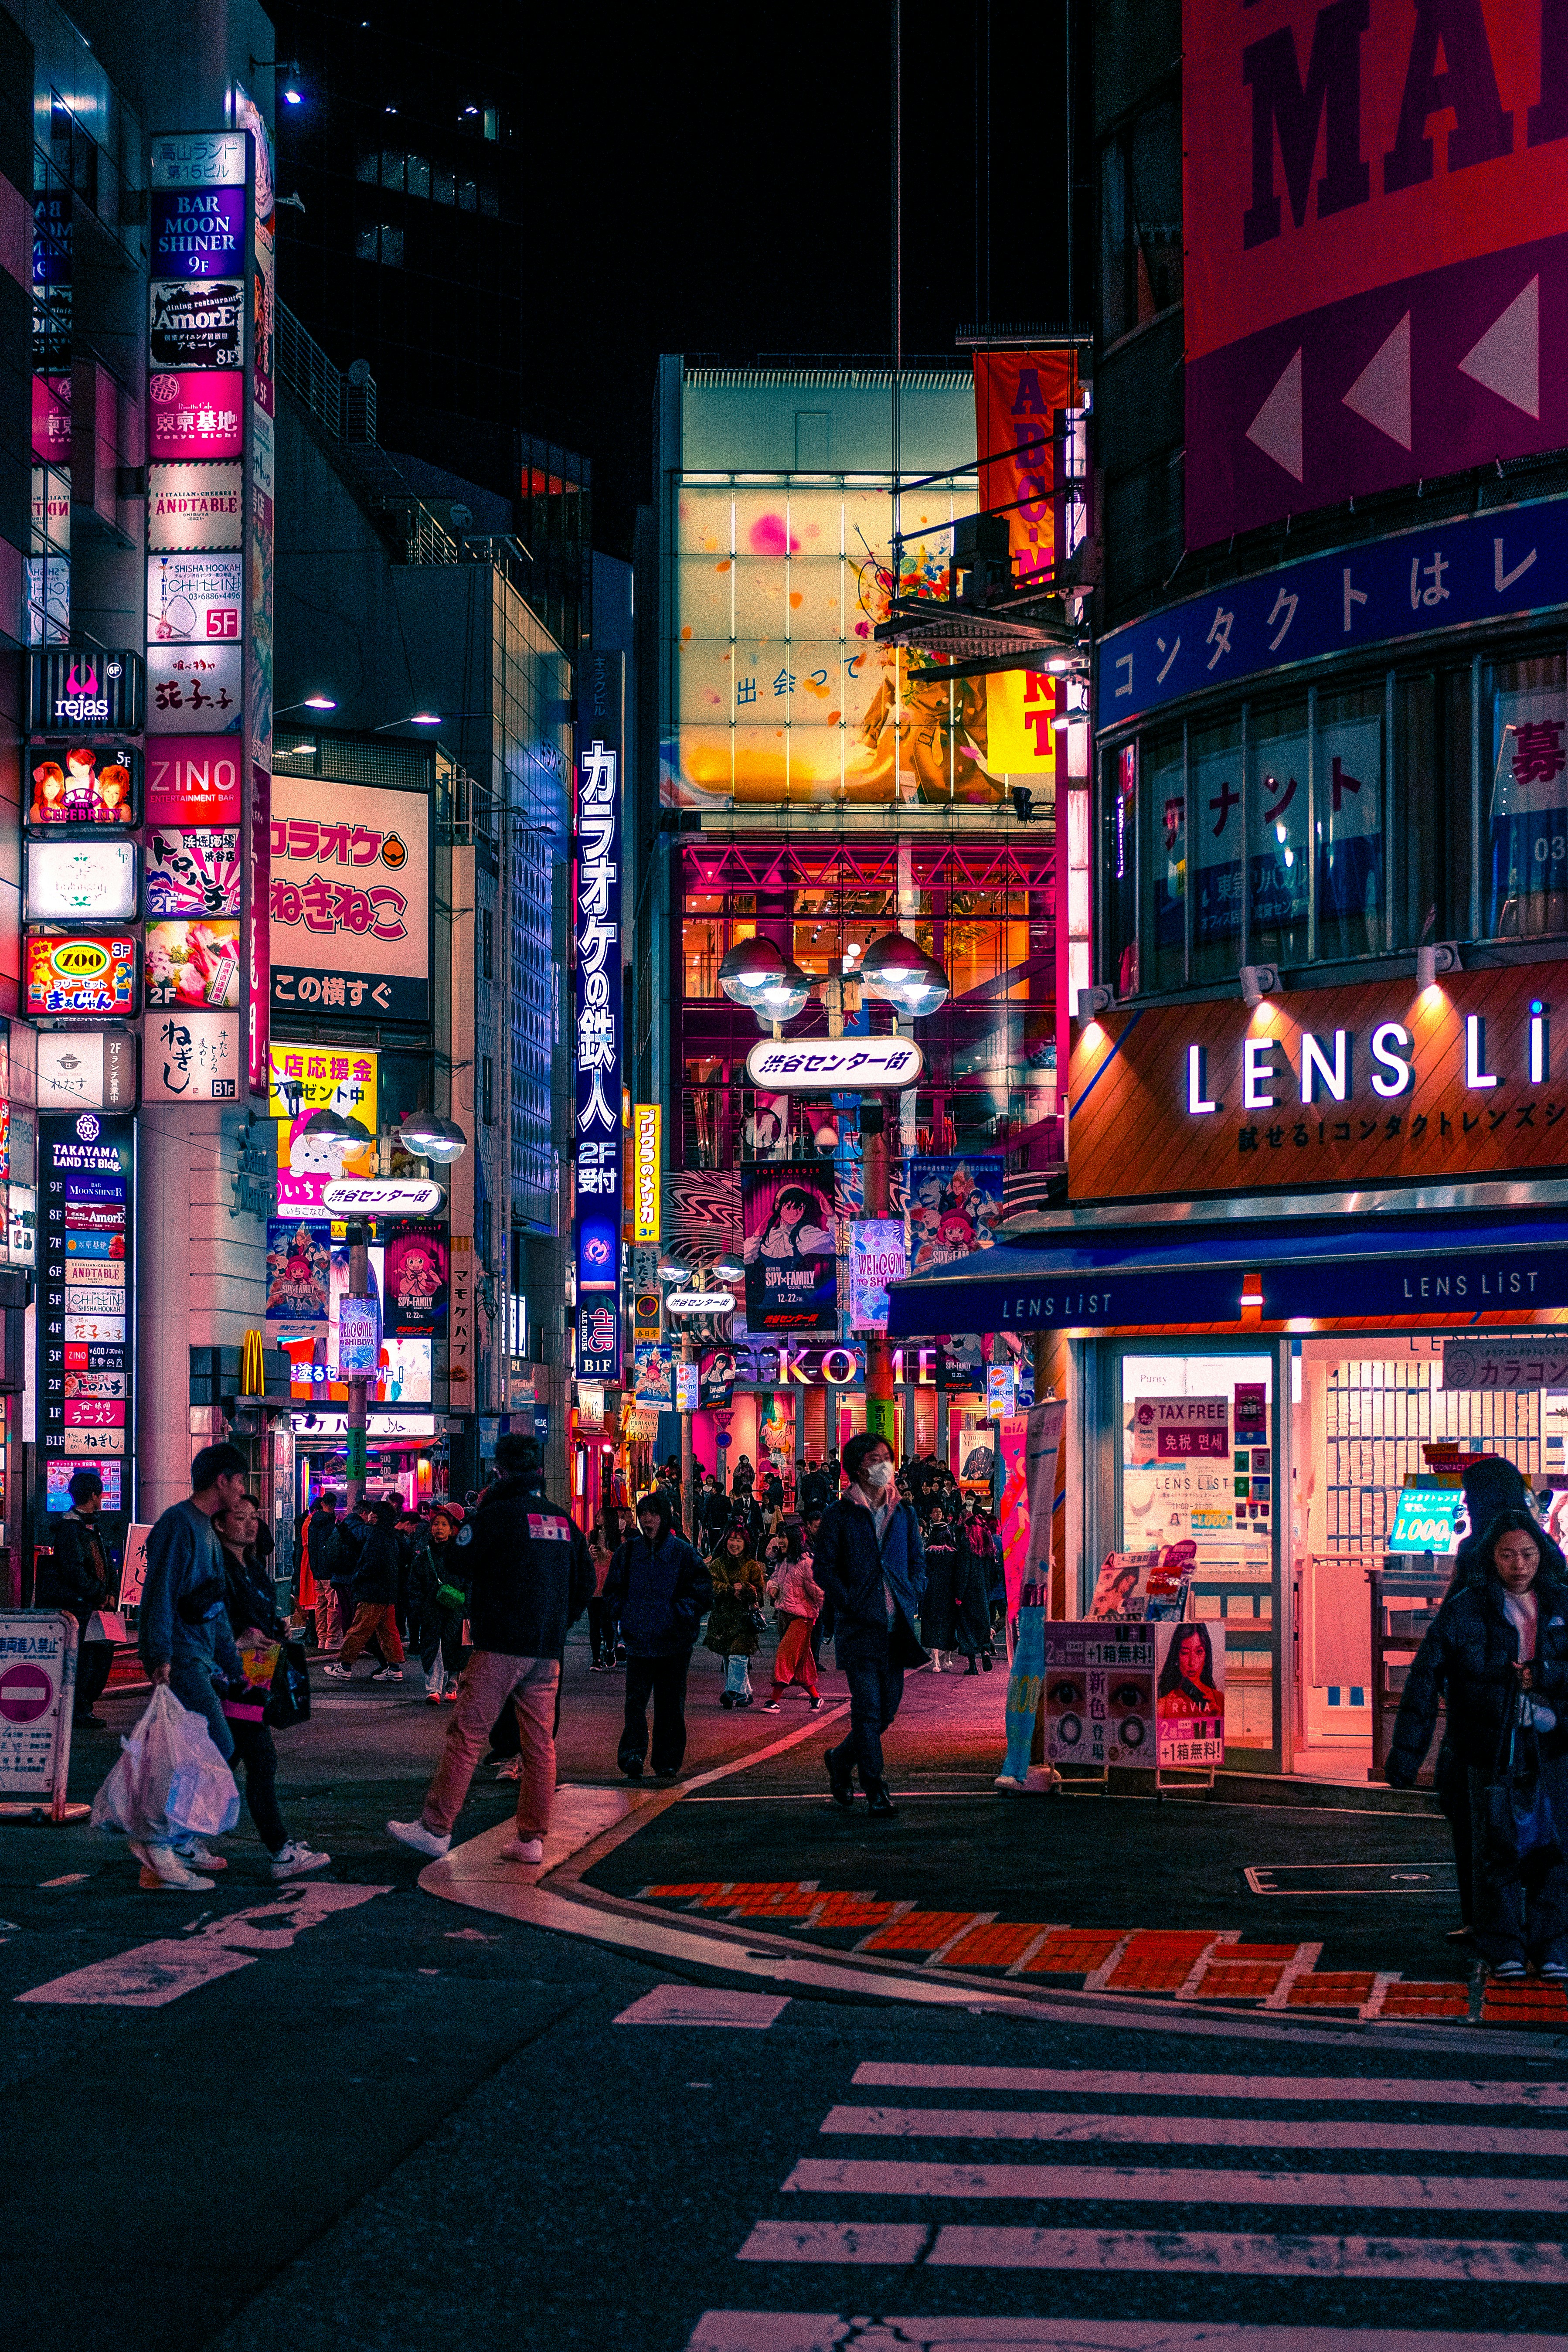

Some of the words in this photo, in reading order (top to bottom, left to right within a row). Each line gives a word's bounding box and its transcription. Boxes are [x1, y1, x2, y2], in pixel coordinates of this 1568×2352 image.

[160, 143, 237, 161] 高山ランド
[167, 164, 229, 180] 第15ビル
[177, 196, 220, 213] BAR
[166, 216, 229, 235] MOON
[159, 235, 236, 252] SHINER
[188, 256, 209, 273] 9F
[166, 302, 192, 312] dining
[154, 306, 237, 329] AmorE
[178, 341, 217, 351] アモーレ
[216, 349, 238, 364] 8F
[155, 497, 238, 515] ANDTABLE
[175, 565, 204, 573] SHISHA
[206, 564, 241, 572] HOOKAH
[208, 612, 236, 635] 5F
[1115, 538, 1537, 697] コンタクトはレ
[109, 665, 119, 674] 6F
[737, 655, 860, 705] 出会って
[55, 694, 108, 721] rejas
[116, 751, 131, 767] 5F
[150, 760, 236, 791] ZINO
[150, 794, 216, 803] ENTERTAINMENT
[40, 807, 123, 822] CELEBRITY
[115, 848, 129, 864] 4F
[204, 851, 235, 862] 渋谷店
[151, 896, 178, 912] 2F
[578, 740, 617, 1133] カラオケの鉄人
[112, 943, 130, 958] 3F
[62, 953, 102, 967] ZOO
[54, 980, 80, 990] フリー
[83, 980, 108, 989] セット
[275, 974, 392, 1009] この横すぐ
[150, 987, 177, 1004] 2F
[110, 1043, 121, 1054] 2F
[218, 1030, 229, 1058] 牛たん
[160, 1018, 193, 1095] ねぎし
[197, 1038, 207, 1067] 麦めし
[758, 1051, 913, 1073] 渋谷センター街
[1187, 1021, 1412, 1115] LENS
[51, 1078, 87, 1090] れたす
[109, 1055, 119, 1103] ランチ営業中
[213, 1081, 235, 1096] B1F
[53, 1144, 119, 1158] TAKAYAMA
[579, 1142, 616, 1164] 2F
[53, 1156, 82, 1167] LAND
[84, 1158, 95, 1168] 15
[98, 1159, 122, 1172] Bldg.
[639, 1109, 656, 1223] プリクラのメッカ
[50, 1181, 62, 1192] 9F
[578, 1167, 617, 1193] 受付
[327, 1189, 432, 1203] 渋谷センター街
[49, 1209, 62, 1220] 8F
[88, 1211, 125, 1223] AmorE
[639, 1228, 655, 1236] 3F
[49, 1237, 62, 1248] 7F
[49, 1266, 62, 1276] 6F
[857, 1252, 905, 1276] WELCOME
[72, 1268, 120, 1280] ANDTABLE
[1403, 1276, 1468, 1299] LENS
[48, 1294, 62, 1305] 5F
[670, 1298, 730, 1307] 渋谷センター街
[453, 1270, 469, 1356] マモケバブ
[1003, 1297, 1054, 1319] LENS
[764, 1313, 819, 1324] 渋谷センター街
[48, 1322, 62, 1333] 4F
[340, 1322, 372, 1338] WELCOME
[589, 1308, 614, 1353] HUB
[48, 1351, 61, 1362] 3F
[68, 1351, 86, 1359] ZINO
[583, 1359, 612, 1372] B1F
[1482, 1359, 1568, 1386] カラコン
[48, 1379, 61, 1390] 2F
[1140, 1374, 1167, 1385] Purity
[49, 1407, 61, 1418] 1F
[71, 1412, 116, 1424] ラーメン
[1158, 1404, 1184, 1420] TAX
[1189, 1403, 1225, 1419] FREE
[383, 1417, 406, 1433] حلال
[46, 1436, 65, 1446] B1F
[84, 1433, 120, 1450] ねぎし
[630, 1432, 656, 1441] 400円
[1165, 1433, 1191, 1451] 免税
[1198, 1433, 1223, 1451] 면세
[380, 1455, 391, 1463] 500
[1156, 1478, 1190, 1490] LENS
[1090, 1671, 1106, 1761] 新色登場
[1161, 1742, 1221, 1765] +1箱無料!
